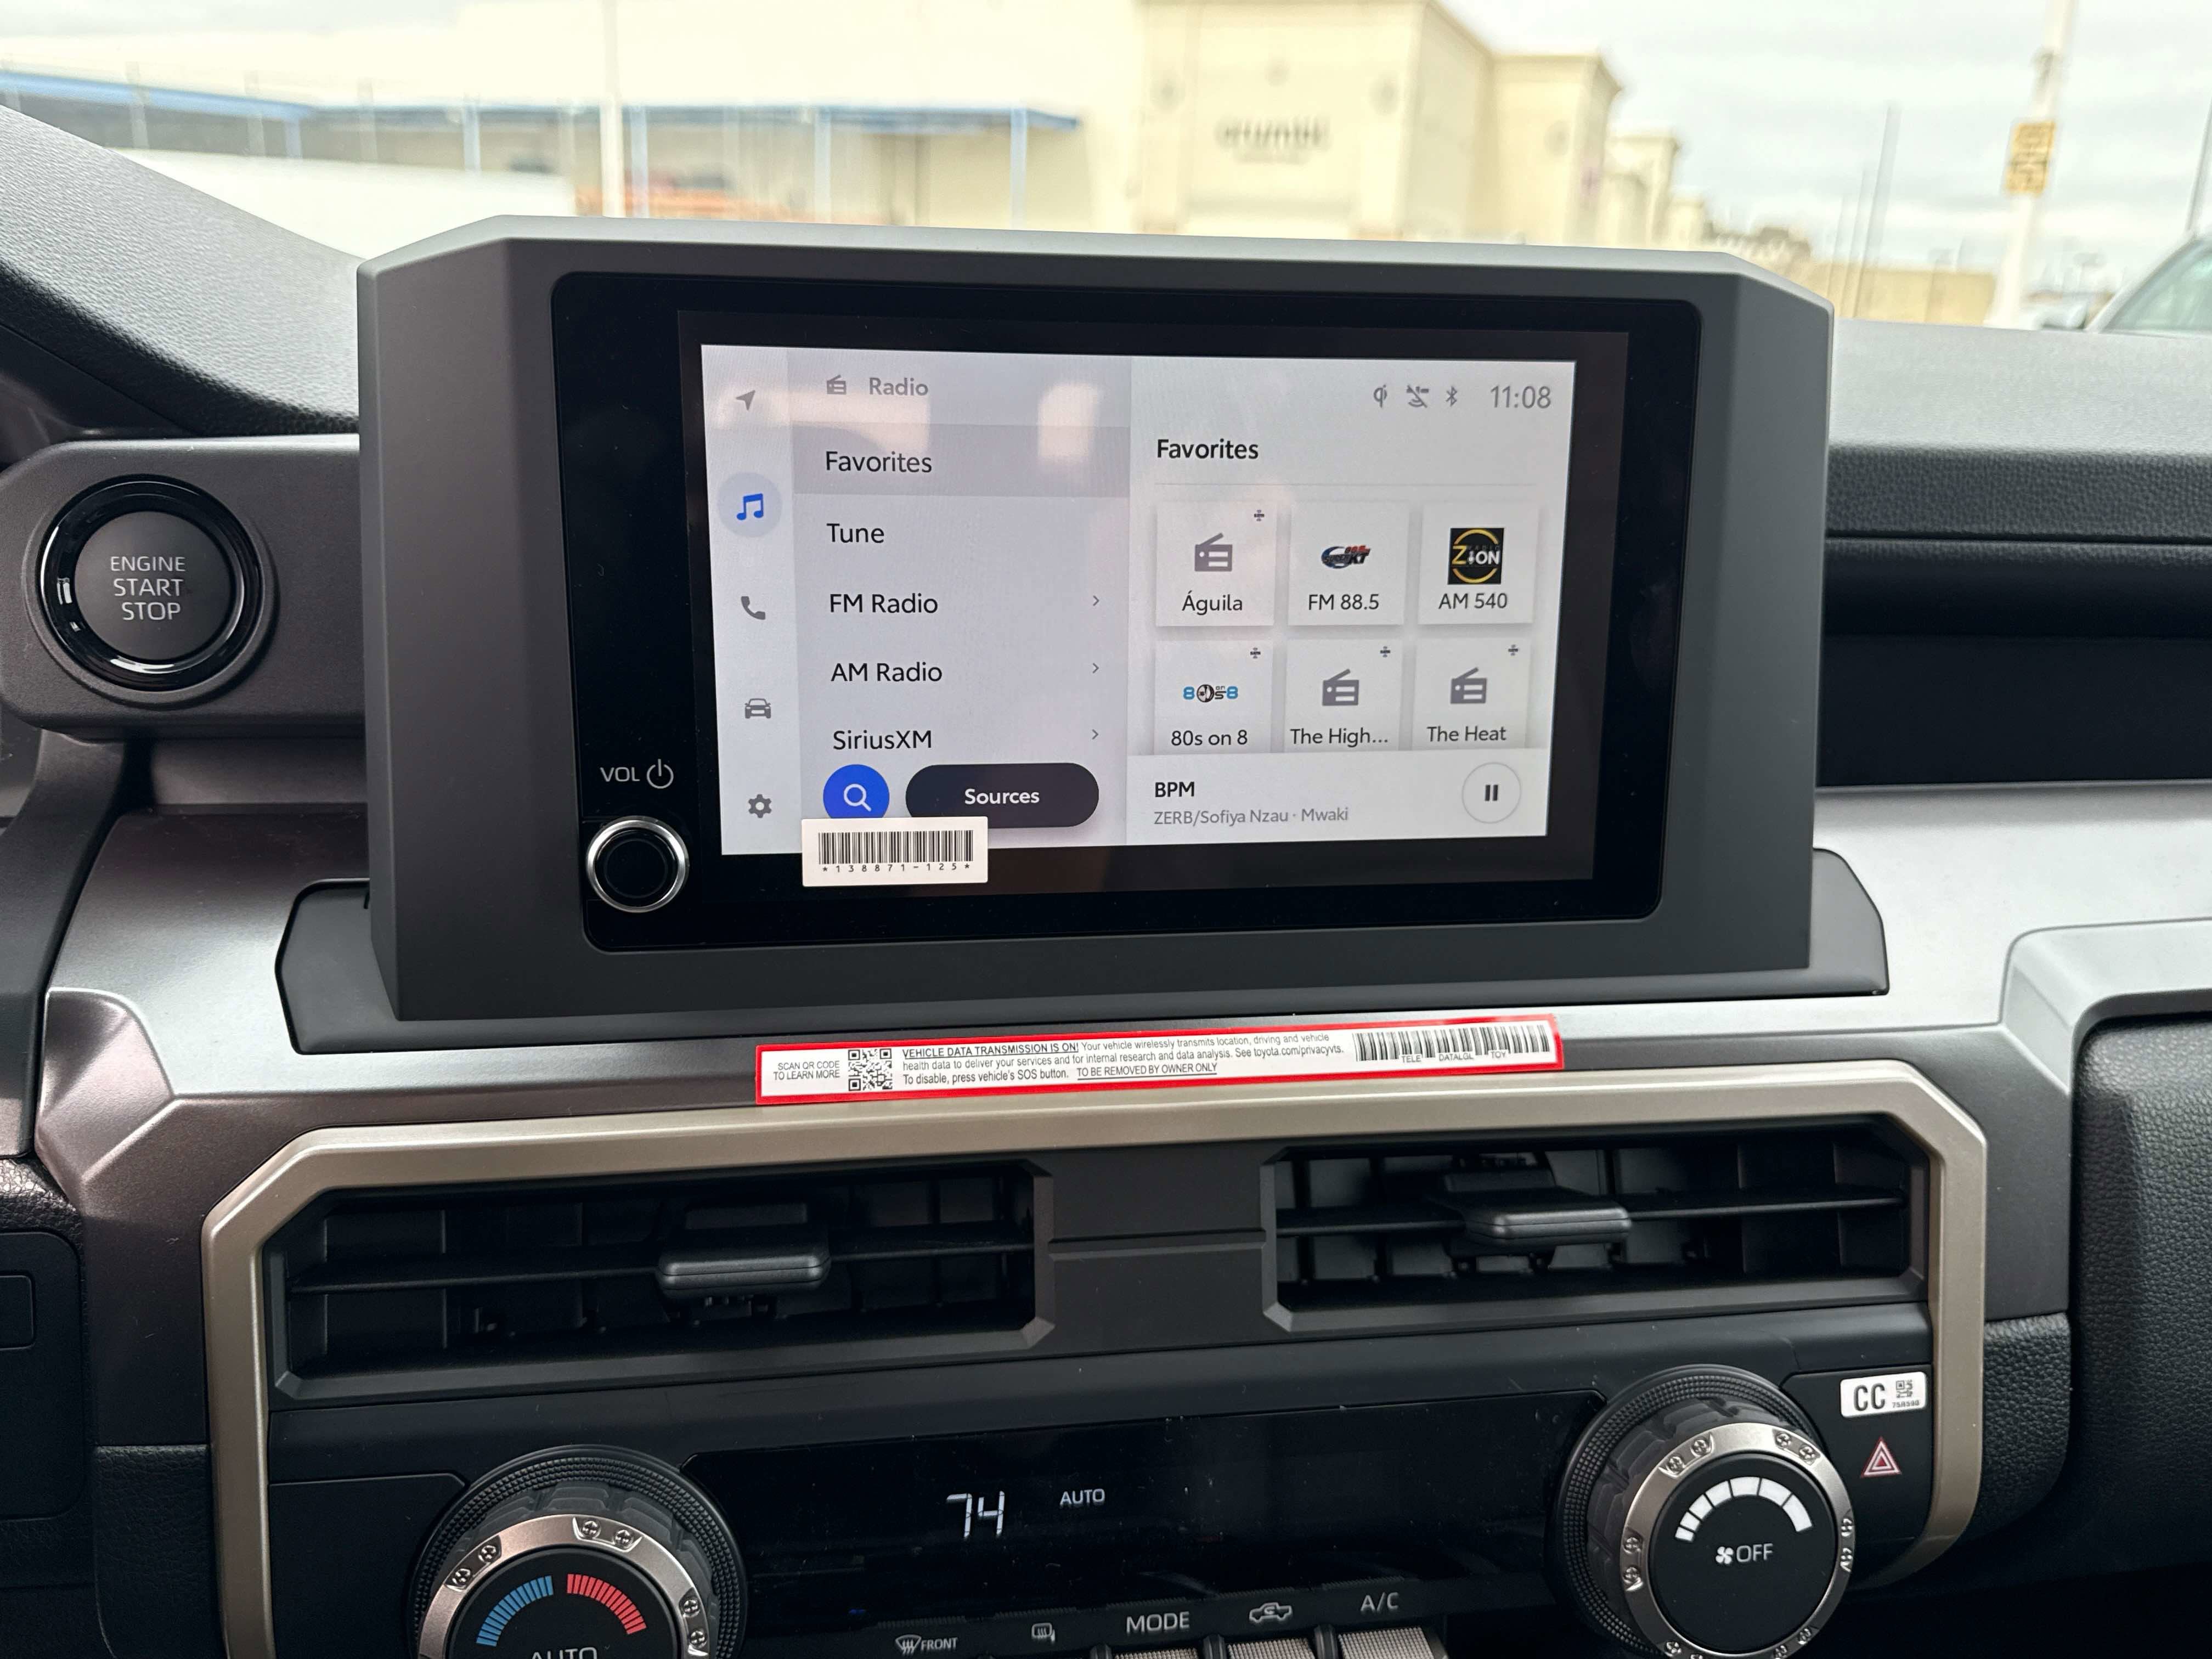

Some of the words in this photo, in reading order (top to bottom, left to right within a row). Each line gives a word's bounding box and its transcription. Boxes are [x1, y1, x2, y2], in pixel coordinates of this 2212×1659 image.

[868, 377, 928, 396] Radio
[1491, 386, 1551, 409] 11:08
[1158, 438, 1258, 459] Favorites
[826, 452, 932, 472] Favorites
[827, 523, 884, 543] Tune
[110, 556, 186, 572] ENGINE
[114, 578, 183, 596] START
[831, 594, 862, 612] FM
[872, 593, 938, 613] Radio
[1182, 590, 1242, 615] Águila
[1309, 595, 1334, 610] FM
[1341, 594, 1379, 610] 88.5
[1438, 593, 1468, 609] AM
[1475, 593, 1507, 608] 540
[122, 602, 180, 620] STOP
[831, 663, 867, 681] AM
[877, 662, 942, 681] Radio
[833, 730, 931, 749] SiriusXM
[1171, 731, 1203, 746] 80s
[1209, 735, 1231, 745] on
[1237, 730, 1247, 744] 8
[1290, 728, 1323, 744] The
[1427, 726, 1459, 742] The
[1465, 726, 1506, 741] Heat
[600, 767, 640, 782] VOL
[965, 789, 1039, 804] Sources
[1155, 782, 1194, 797] BPM
[1154, 810, 1245, 826] ZERB/Sofiya
[1250, 810, 1288, 822] Nzau
[1302, 808, 1348, 821] Mwaki
[902, 1048, 944, 1058] VEHICLE
[947, 1046, 972, 1057] DATA
[975, 1043, 1048, 1055] TRANSMISSION
[1051, 1043, 1059, 1052] IS
[1062, 1042, 1079, 1052] ON!
[1081, 1041, 1101, 1051] Your
[1104, 1040, 1132, 1049] vehicle
[1135, 1039, 1175, 1050] wirelessly
[1177, 1037, 1215, 1047] transmits
[1217, 1035, 1251, 1046] location,
[1254, 1035, 1281, 1045] driving
[1283, 1034, 1299, 1042] and
[1301, 1032, 1329, 1042] vehicle
[1491, 1050, 1506, 1058] TOY
[778, 1062, 800, 1070] SCAN
[816, 1060, 840, 1069] CODE
[903, 1060, 929, 1071] health
[932, 1059, 951, 1070] data
[953, 1059, 962, 1069] to
[965, 1059, 994, 1069] deliver
[996, 1058, 1014, 1069] your
[1017, 1057, 1052, 1066] services
[1054, 1054, 1070, 1064] and
[1073, 1054, 1084, 1064] for
[1086, 1052, 1117, 1063] internal
[1120, 1050, 1156, 1062] research
[1158, 1051, 1174, 1060] and
[1176, 1050, 1194, 1060] data
[1197, 1048, 1233, 1060] analysis.
[1235, 1047, 1251, 1057] See
[773, 1071, 785, 1081] TO
[786, 1070, 814, 1080] LEARN
[816, 1069, 840, 1079] MORE
[903, 1074, 913, 1084] To
[916, 1072, 949, 1084] disable,
[952, 1073, 976, 1085] press
[978, 1069, 1015, 1081] vehicle's
[1018, 1069, 1037, 1080] SOS
[1040, 1068, 1069, 1079] button.
[1077, 1068, 1088, 1077] TO
[1091, 1066, 1102, 1076] BE
[1104, 1065, 1147, 1076] REMOVED
[1149, 1064, 1160, 1074] BY
[1161, 1063, 1194, 1073] OWNER
[1195, 1062, 1217, 1072] ONLY
[1854, 1383, 1885, 1412] CC
[1060, 1489, 1105, 1505] AUTO
[947, 1491, 1005, 1537] 74
[1736, 1543, 1774, 1563] OFF
[1360, 1592, 1398, 1611] A/C
[1126, 1611, 1190, 1633] MODE
[921, 1637, 958, 1651] FRONT
